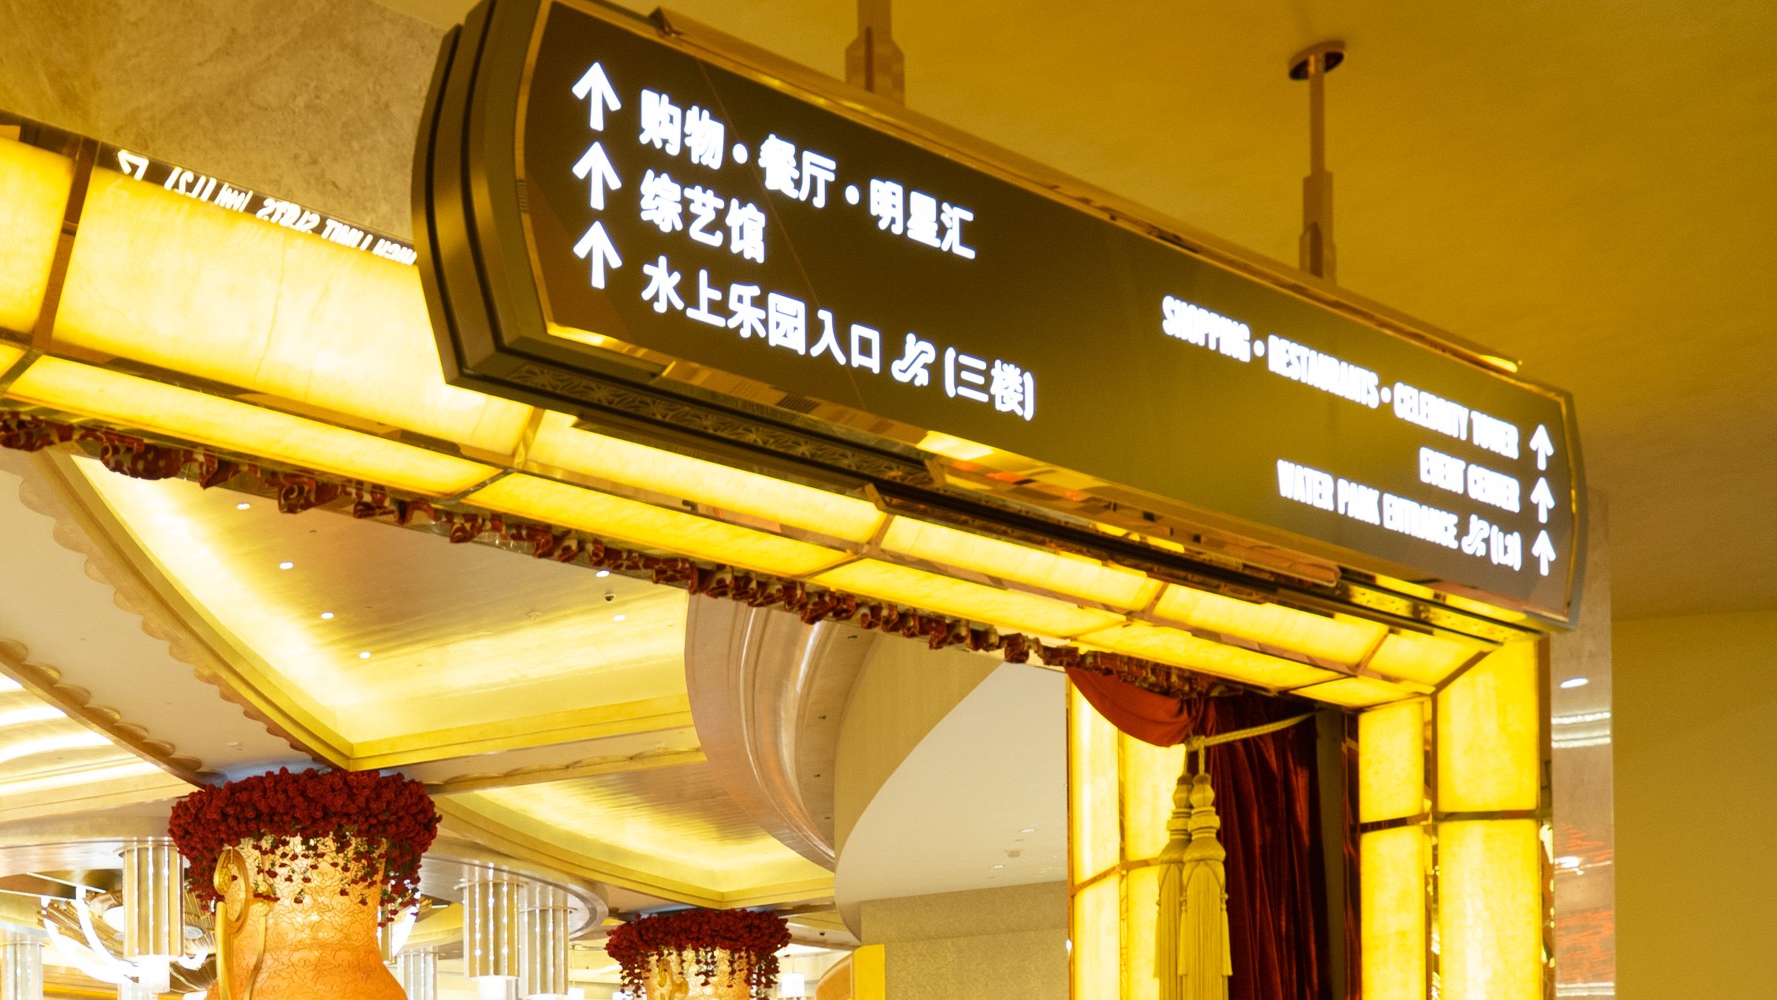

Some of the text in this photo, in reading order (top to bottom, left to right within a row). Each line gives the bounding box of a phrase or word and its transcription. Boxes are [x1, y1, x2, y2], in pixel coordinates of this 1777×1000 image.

[640, 169, 766, 264] 综艺馆
[641, 256, 1035, 421] 水上乐园入口 (三楼)
[1162, 295, 1519, 459] SHOPPING RESTAURANTS CELEBRITY TOWER
[1277, 459, 1334, 511] WATER
[1337, 478, 1381, 525] PARK
[1383, 493, 1458, 549] ENTRANCE
[1420, 447, 1466, 494] EVENT
